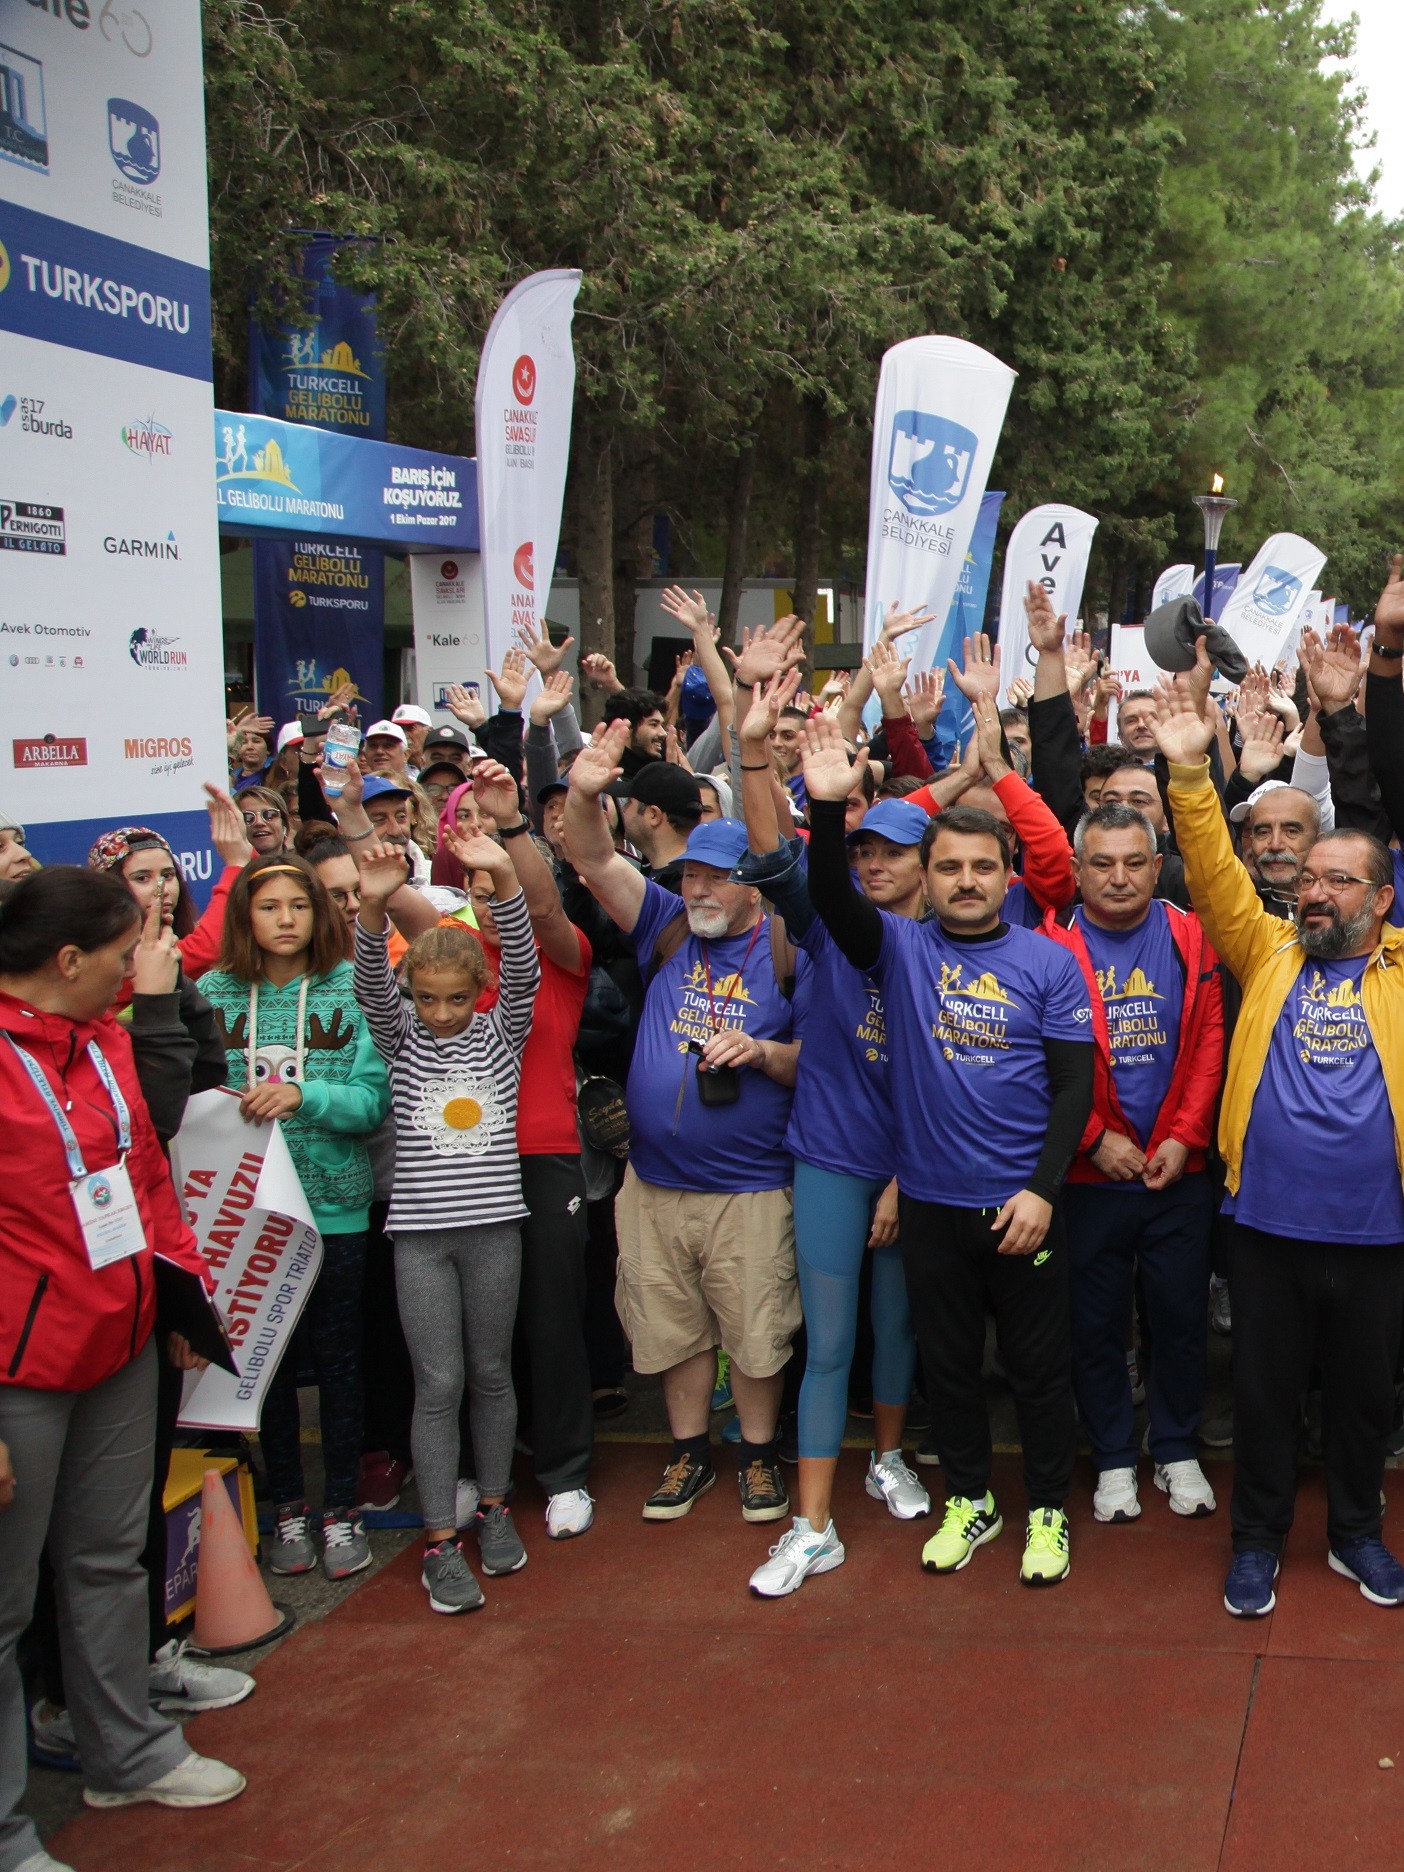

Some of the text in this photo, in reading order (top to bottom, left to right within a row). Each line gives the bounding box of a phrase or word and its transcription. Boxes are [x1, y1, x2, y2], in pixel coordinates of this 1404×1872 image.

[20, 254, 190, 335] TURKSPORU
[287, 373, 364, 395] TURKCELL
[30, 399, 45, 415] 17
[284, 404, 370, 426] MARATONU
[30, 414, 73, 439] burda
[128, 428, 172, 455] HAYAT
[391, 466, 428, 489] BARIŞ
[27, 505, 52, 518] 1860
[285, 497, 344, 520] MARATONU
[396, 513, 415, 524] Ekim
[416, 515, 438, 525] Pazar
[439, 515, 457, 526] 2017
[3, 537, 61, 553] IL GELATO
[103, 536, 179, 560] GARMIN
[294, 542, 362, 559] TURKCELL
[288, 568, 369, 589] MARATONU
[308, 595, 369, 610] TURKSPORU
[0, 622, 91, 637] Avek Otomotiv
[433, 634, 460, 647] Kale
[23, 745, 79, 761] ARBELLA
[684, 991, 747, 1017] TURKCELL
[938, 991, 1009, 1021] TURKCELL
[1301, 1001, 1366, 1023] TURKCELL
[931, 1024, 1012, 1050] MARATONU
[1293, 1024, 1367, 1052] MARATONU
[955, 1053, 996, 1064] TURKCELL
[1118, 1054, 1155, 1064] TURKCELL
[1313, 1056, 1355, 1065] TURKCELL
[267, 1284, 299, 1325] SPOR
